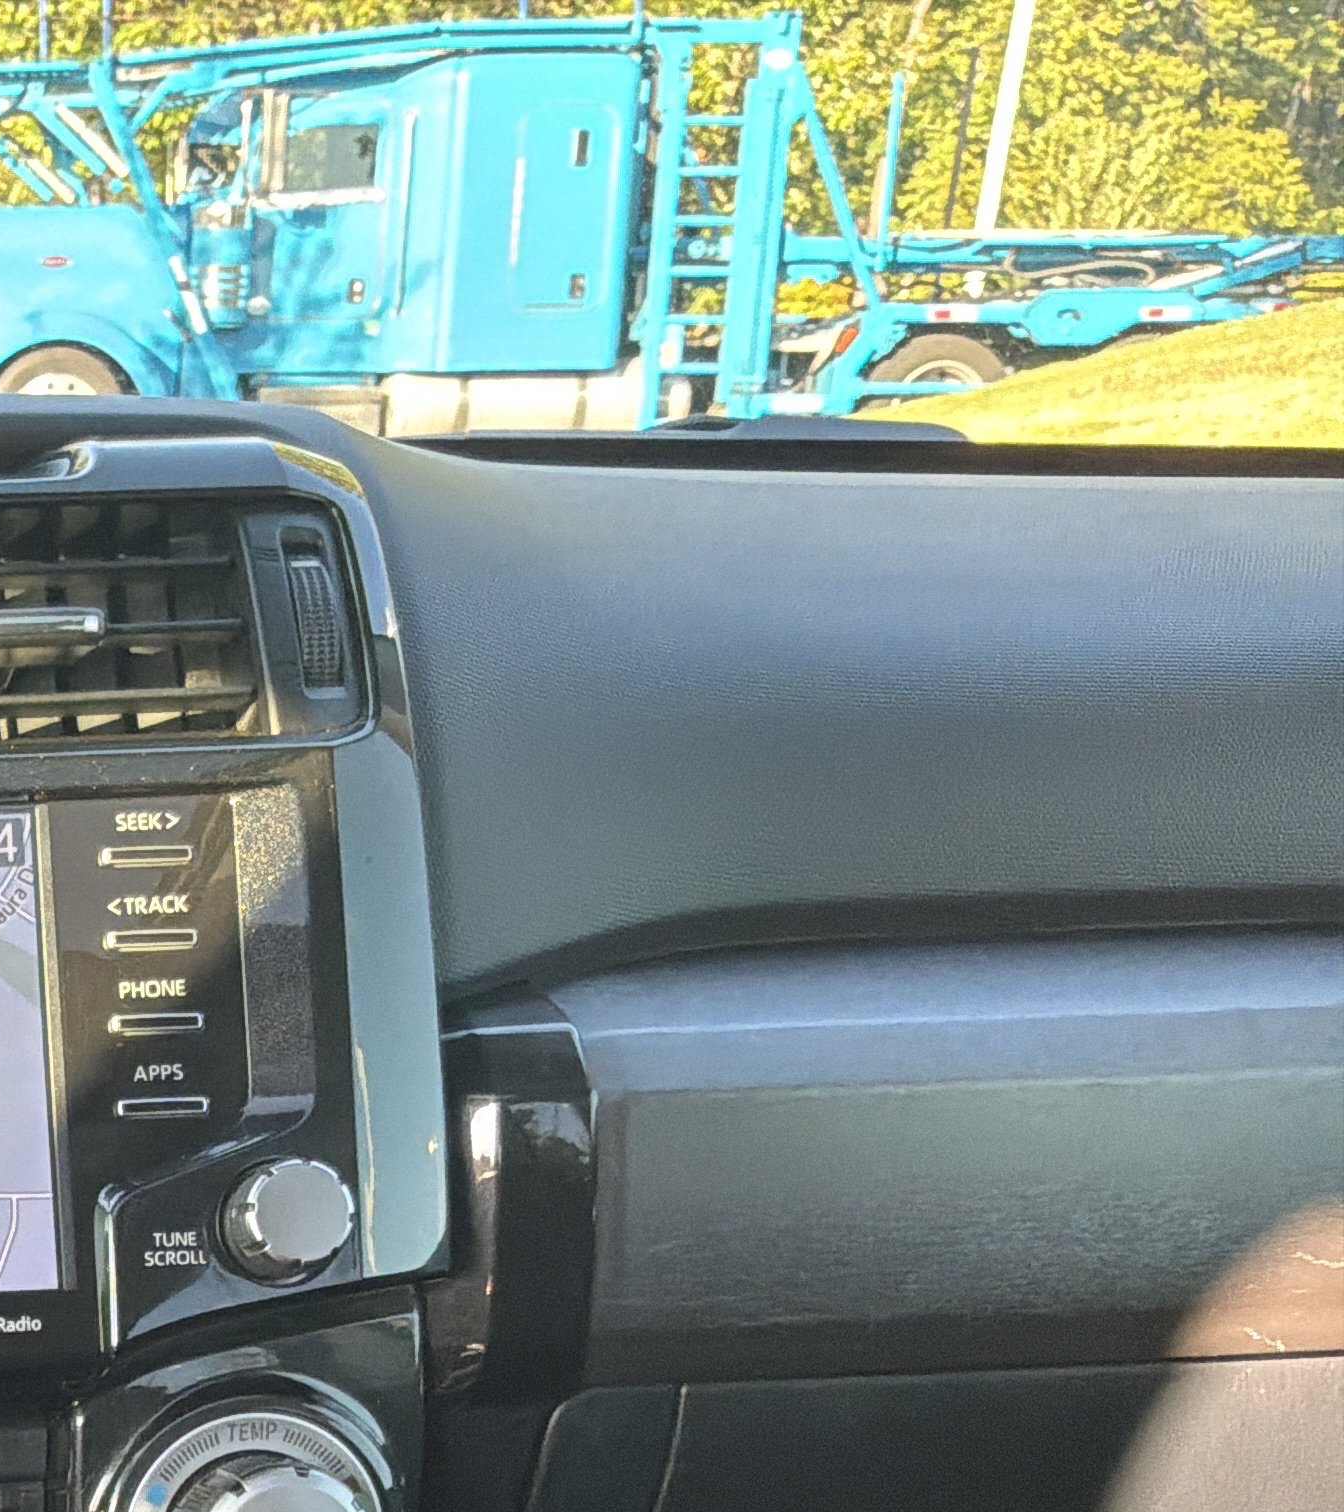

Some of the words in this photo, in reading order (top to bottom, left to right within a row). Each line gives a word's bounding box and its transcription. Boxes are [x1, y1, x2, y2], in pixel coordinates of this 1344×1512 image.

[118, 979, 187, 999] PHONE
[133, 1063, 185, 1082] APPS
[152, 1231, 198, 1248] TUNE
[143, 1249, 208, 1267] SCROLL
[227, 1422, 278, 1442] TEMP
